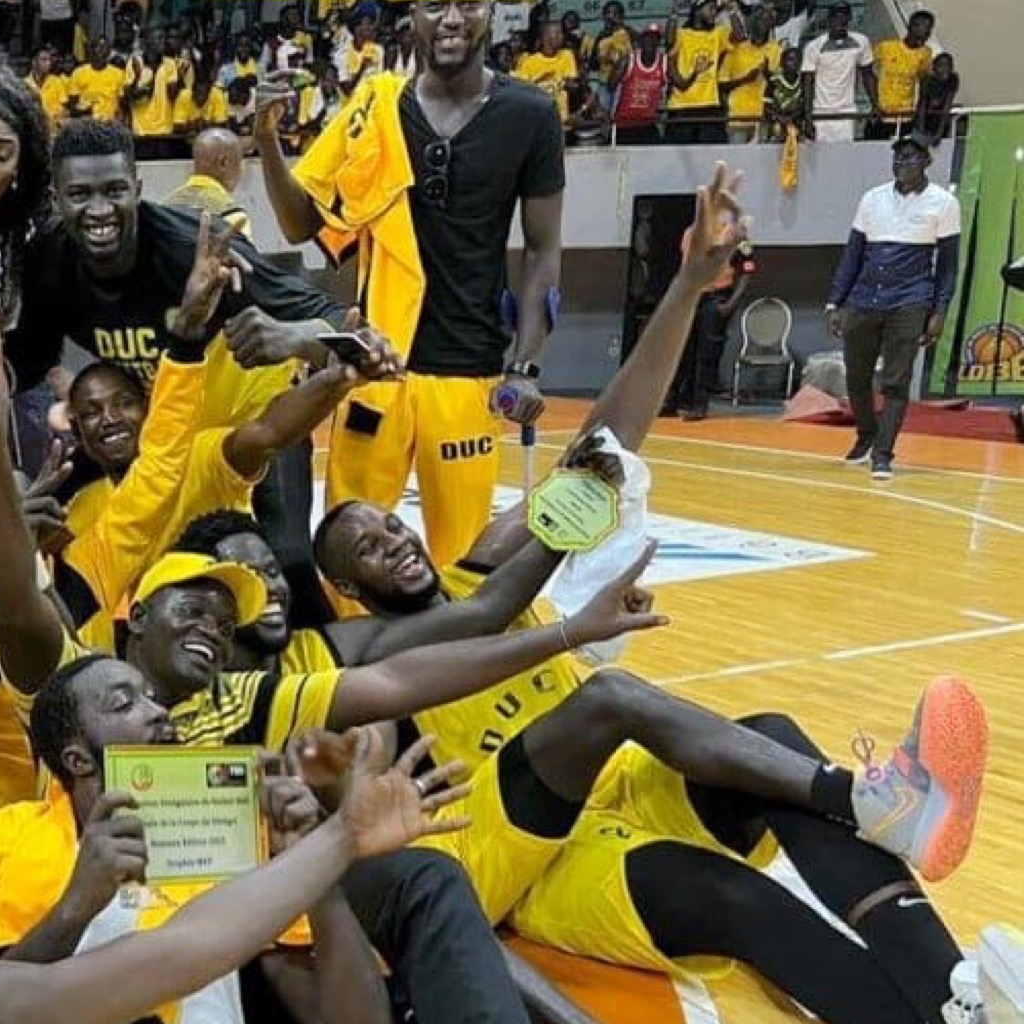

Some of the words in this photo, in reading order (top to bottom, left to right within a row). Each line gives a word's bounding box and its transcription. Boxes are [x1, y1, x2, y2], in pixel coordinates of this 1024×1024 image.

[94, 328, 159, 359] DUC
[440, 436, 494, 460] DUC
[479, 668, 557, 752] DUC
